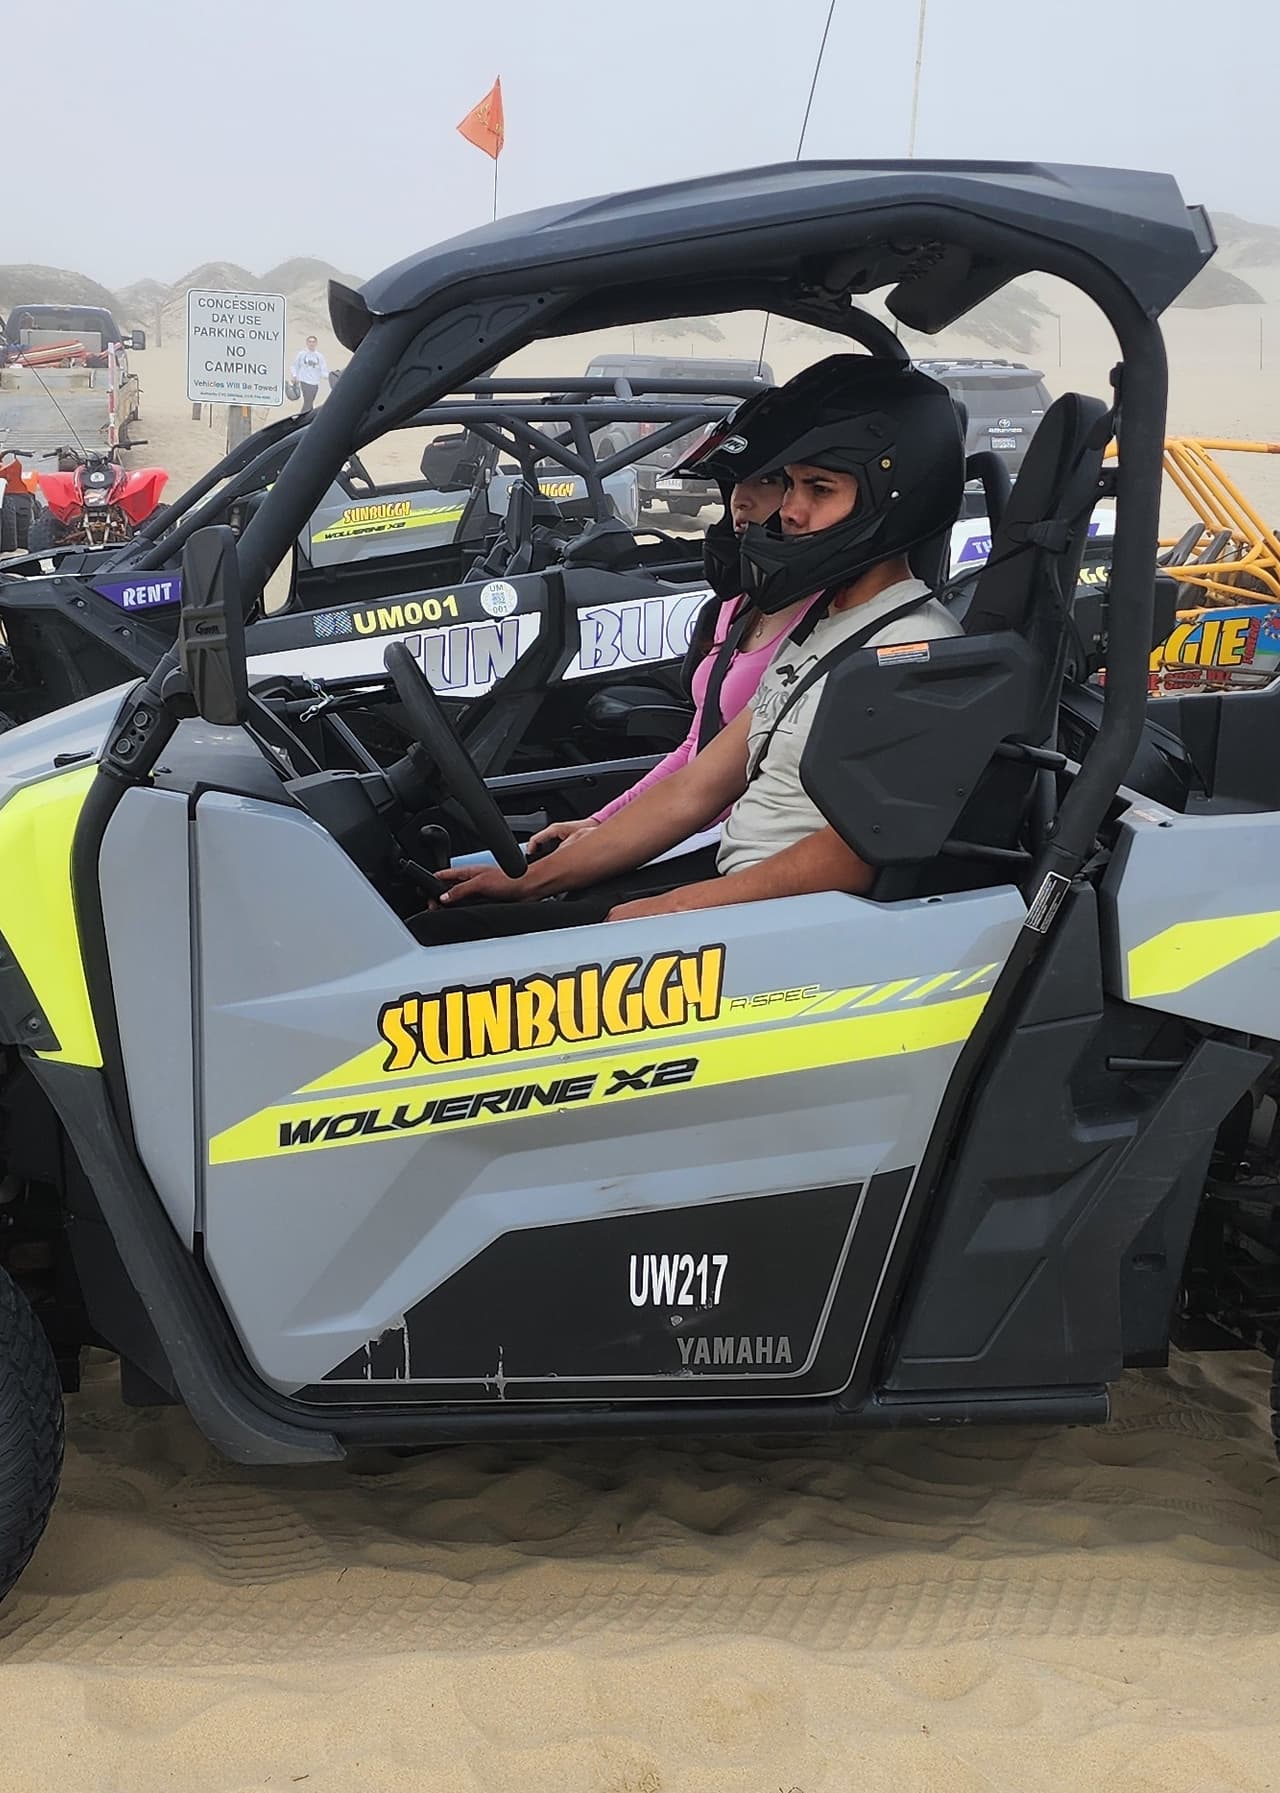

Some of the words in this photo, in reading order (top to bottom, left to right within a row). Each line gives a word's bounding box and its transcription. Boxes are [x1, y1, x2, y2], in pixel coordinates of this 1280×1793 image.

[198, 298, 275, 312] CONCESSION
[212, 313, 234, 324] DAY
[238, 315, 262, 326] USE
[193, 326, 245, 339] PARKING
[249, 330, 280, 341] ONLY
[226, 345, 246, 357] NO
[204, 360, 268, 375] CAMPING
[193, 379, 225, 388] Vehicles
[226, 381, 240, 389] Will
[254, 383, 278, 392] Towed
[343, 501, 411, 524] SUNBUGGY
[121, 582, 173, 607] RENT
[489, 584, 504, 592] UM
[352, 594, 459, 635] UM001
[492, 605, 508, 614] 001
[404, 619, 520, 691] UN
[378, 944, 725, 1071] SUNBUGGY
[279, 1074, 599, 1147] WOLVERINE
[604, 1057, 700, 1096] X2
[629, 1254, 728, 1306] UW217
[676, 1336, 793, 1365] YAMAHA
